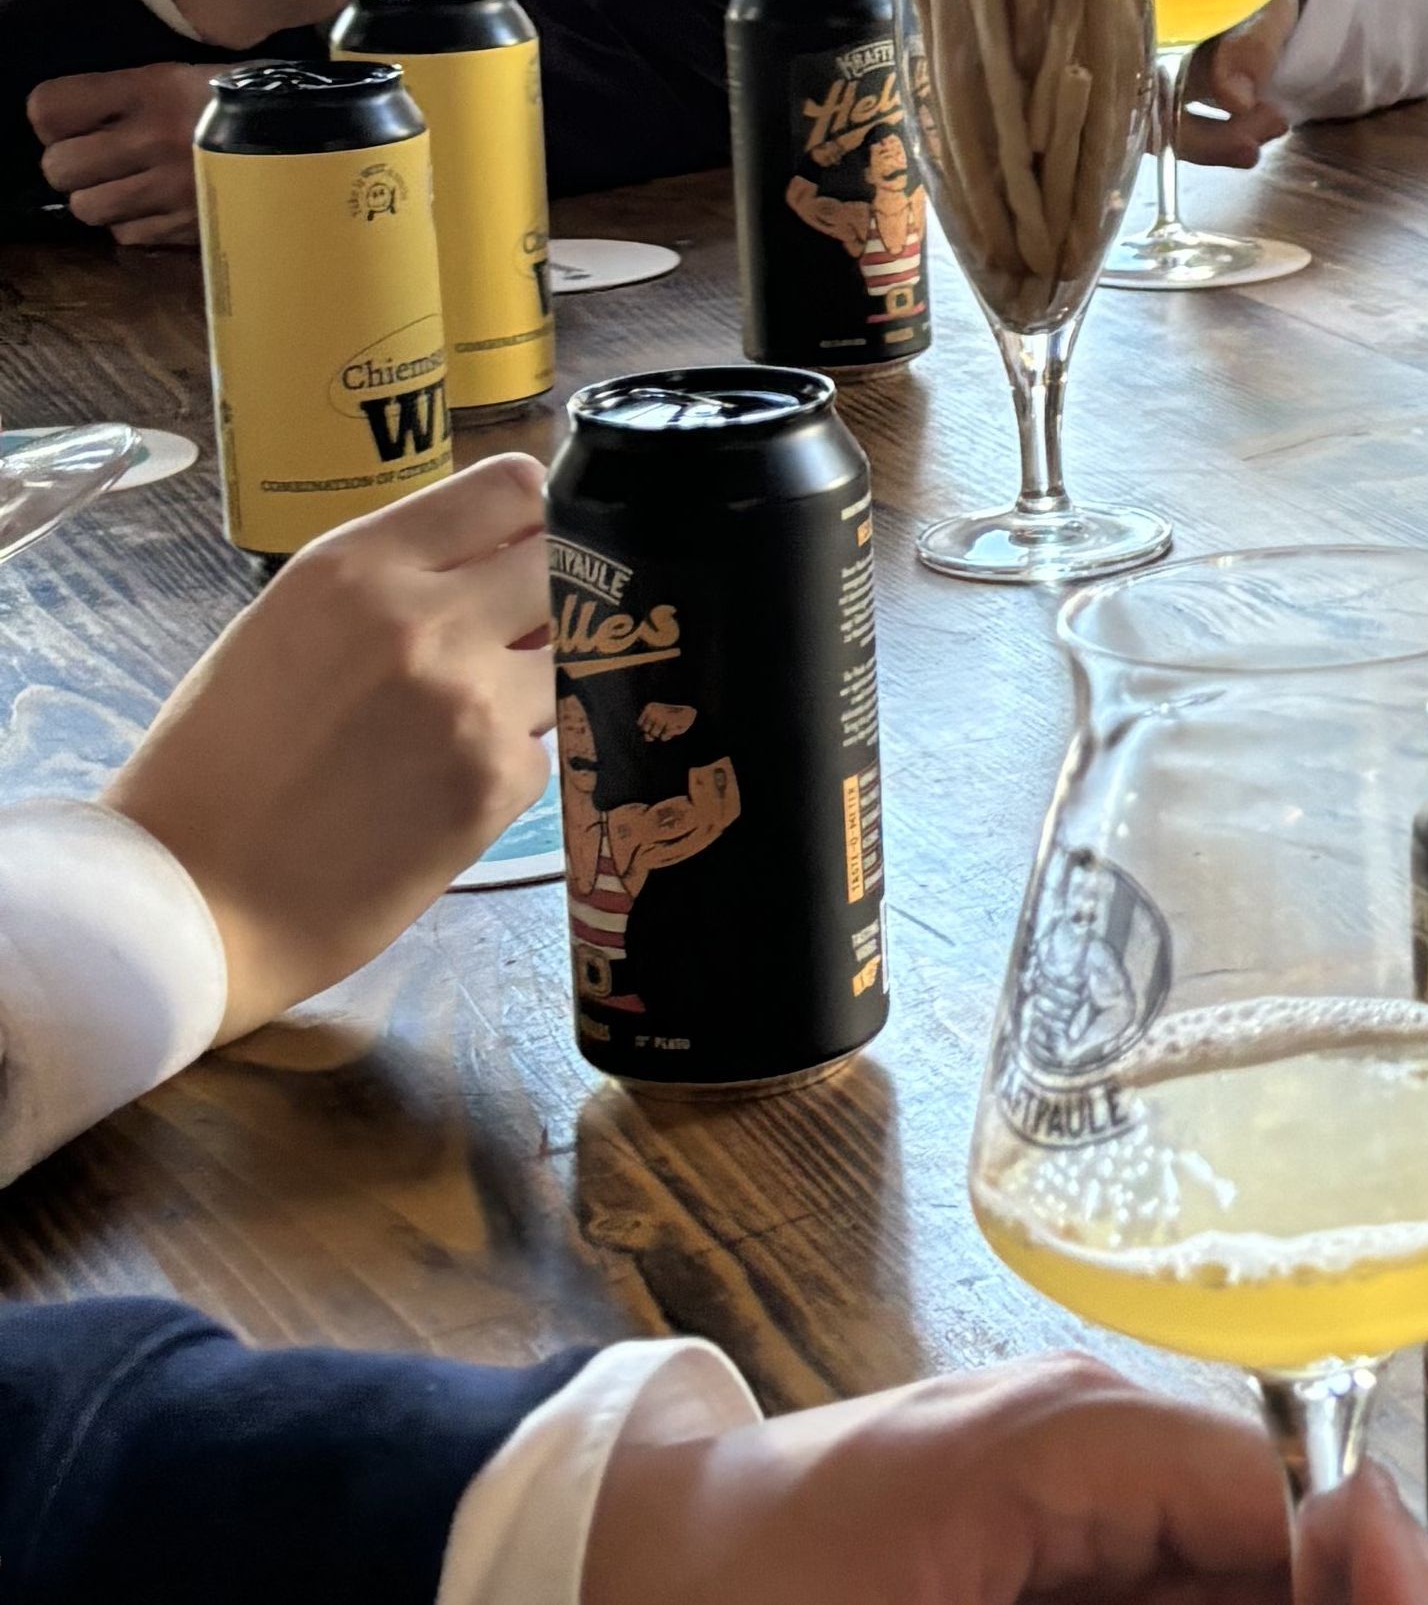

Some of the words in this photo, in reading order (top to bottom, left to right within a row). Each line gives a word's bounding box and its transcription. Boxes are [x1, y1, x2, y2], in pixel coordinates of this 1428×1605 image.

[803, 71, 901, 152] Hel
[342, 349, 444, 391] Chiems
[551, 593, 681, 655] lles
